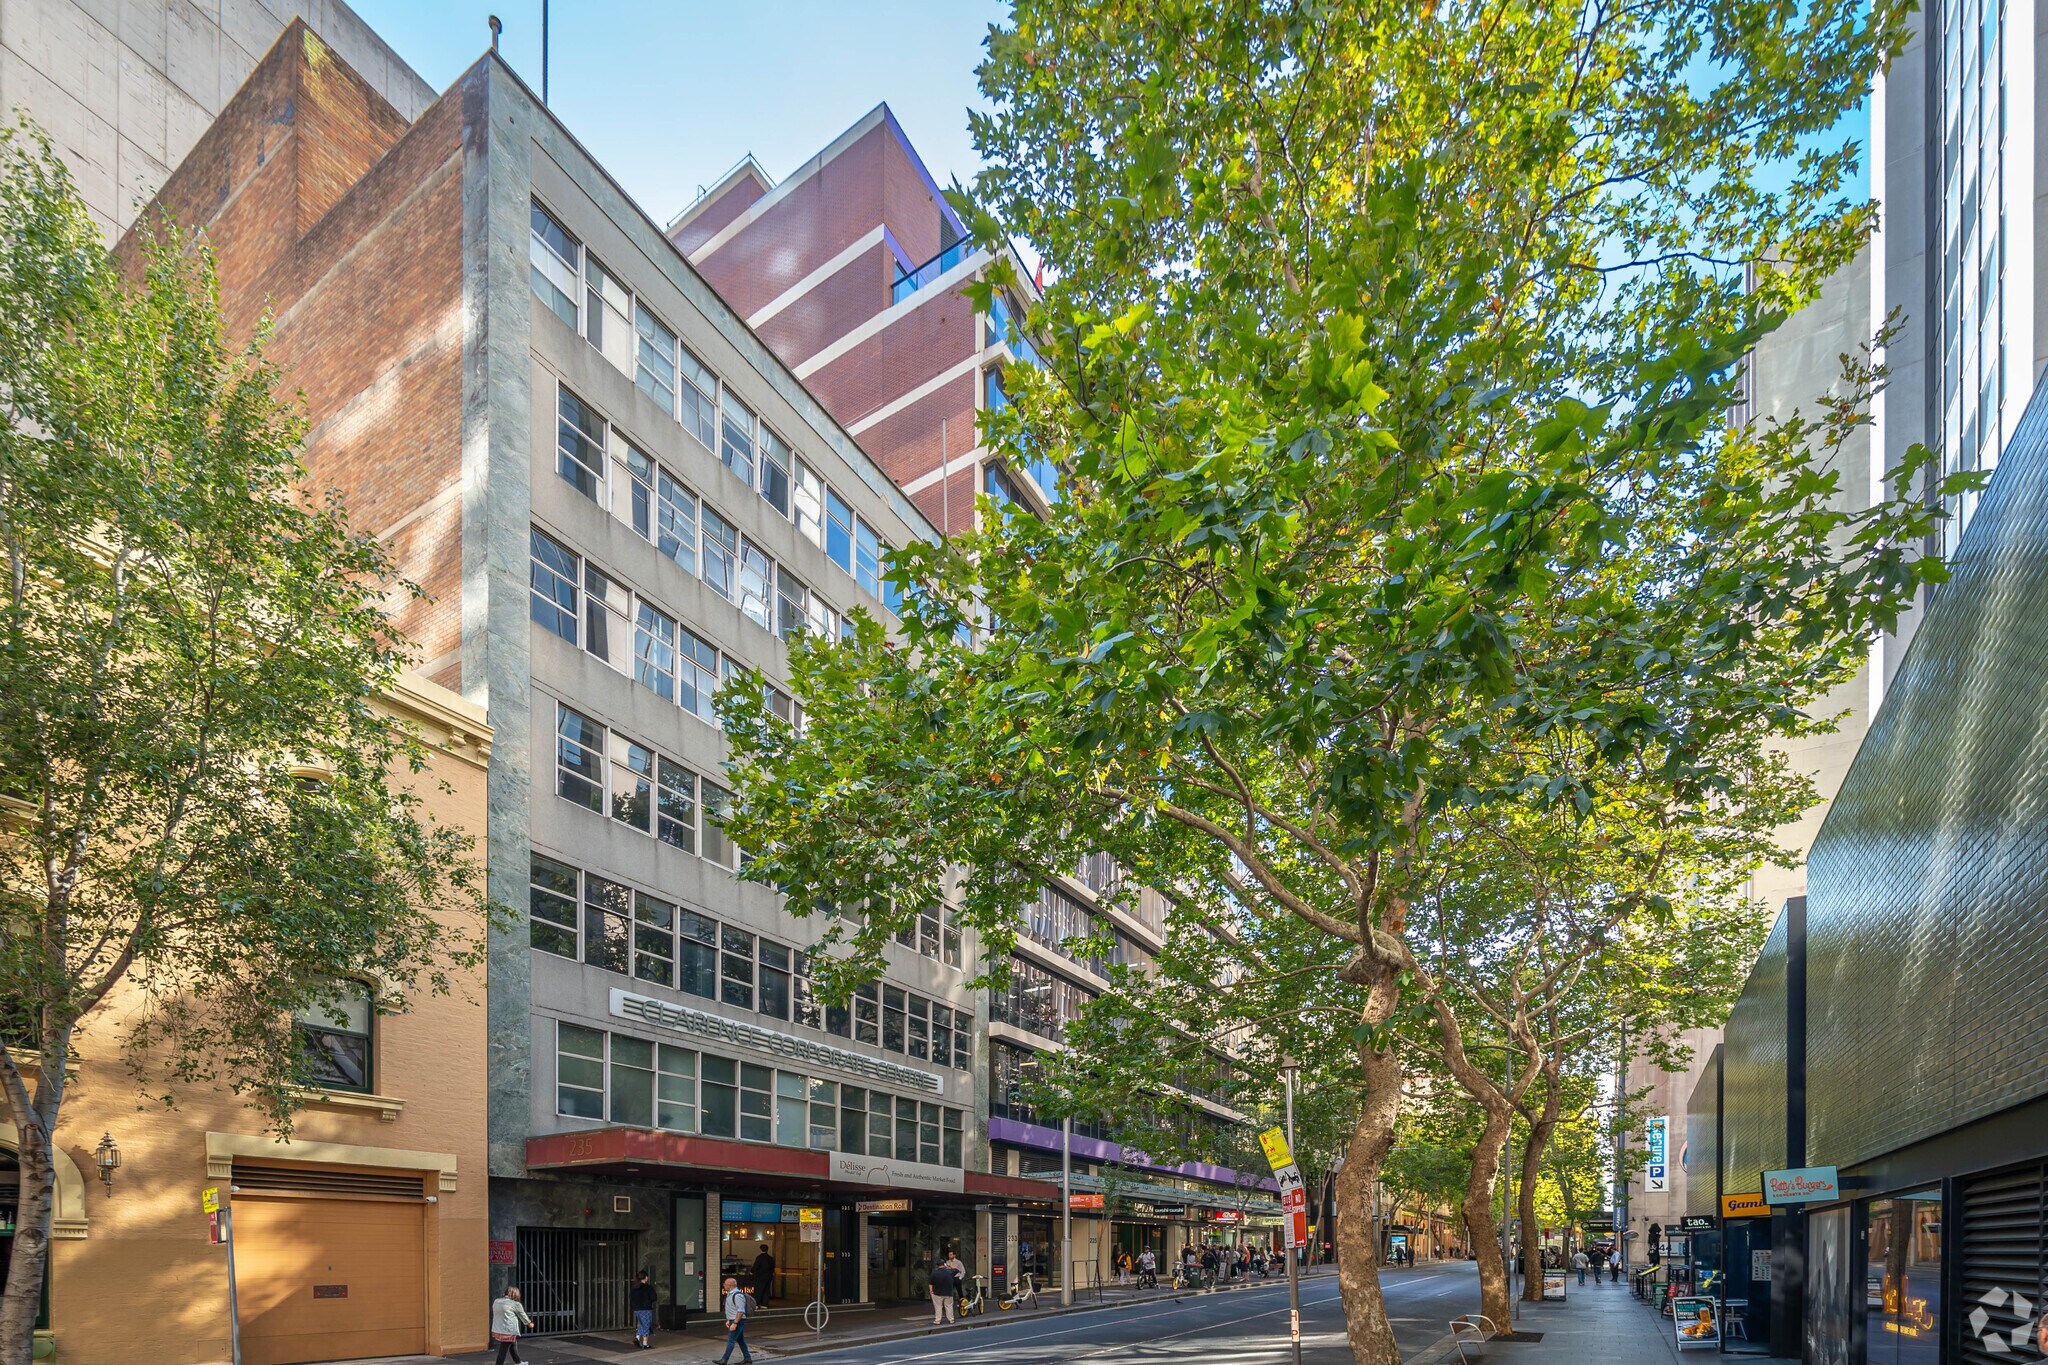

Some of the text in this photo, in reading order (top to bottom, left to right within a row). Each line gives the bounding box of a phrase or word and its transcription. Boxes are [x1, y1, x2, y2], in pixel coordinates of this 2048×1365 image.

[642, 1000, 930, 1090] CLARENCE CORPORATE CENTRE
[569, 1138, 593, 1156] 235
[840, 1160, 866, 1172] Délisse
[1652, 1167, 1662, 1177] P
[913, 1173, 932, 1181] Authentic
[932, 1175, 946, 1183] Market
[1795, 1175, 1834, 1193] Burgers
